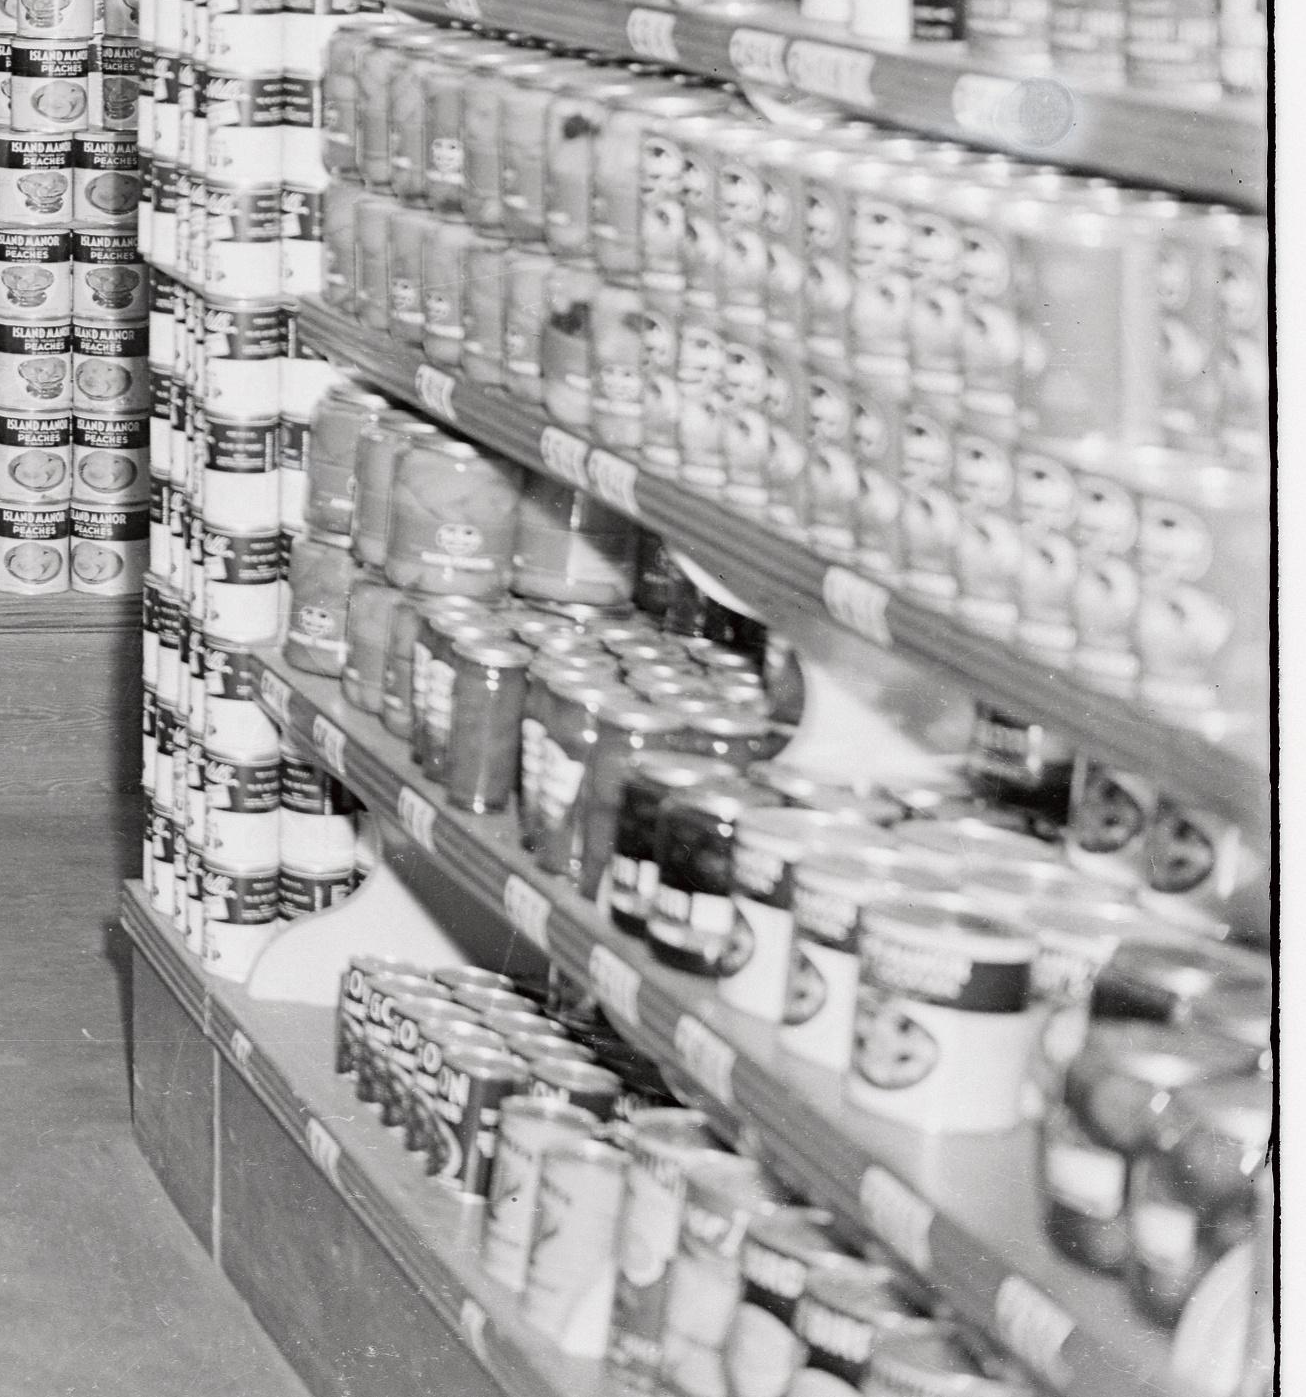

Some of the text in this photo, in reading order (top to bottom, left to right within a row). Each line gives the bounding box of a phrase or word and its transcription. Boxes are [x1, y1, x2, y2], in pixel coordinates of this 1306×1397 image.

[30, 50, 62, 61] ISLAND
[41, 64, 83, 73] PEACHES
[11, 142, 44, 153] ISLAND
[83, 142, 115, 153] ISLAND
[23, 156, 65, 165] PEACHES
[25, 235, 60, 246] MANOR
[80, 236, 111, 247] ISLAND
[5, 249, 48, 259] PEACHES
[90, 251, 135, 260] PEACHES
[12, 326, 45, 337] ISLAND
[99, 329, 135, 341] MANOR
[24, 342, 65, 351] PEACHES
[80, 342, 122, 352] PEACHES
[7, 418, 38, 430] ISLAND
[77, 419, 140, 432] ISLAND MANOR
[17, 433, 61, 442] PEACHES
[84, 434, 128, 444] PEACHES
[3, 510, 35, 523] ISLAND
[90, 511, 127, 524] MANOR
[12, 525, 56, 536] PEACHES
[74, 524, 113, 537] PEACHES
